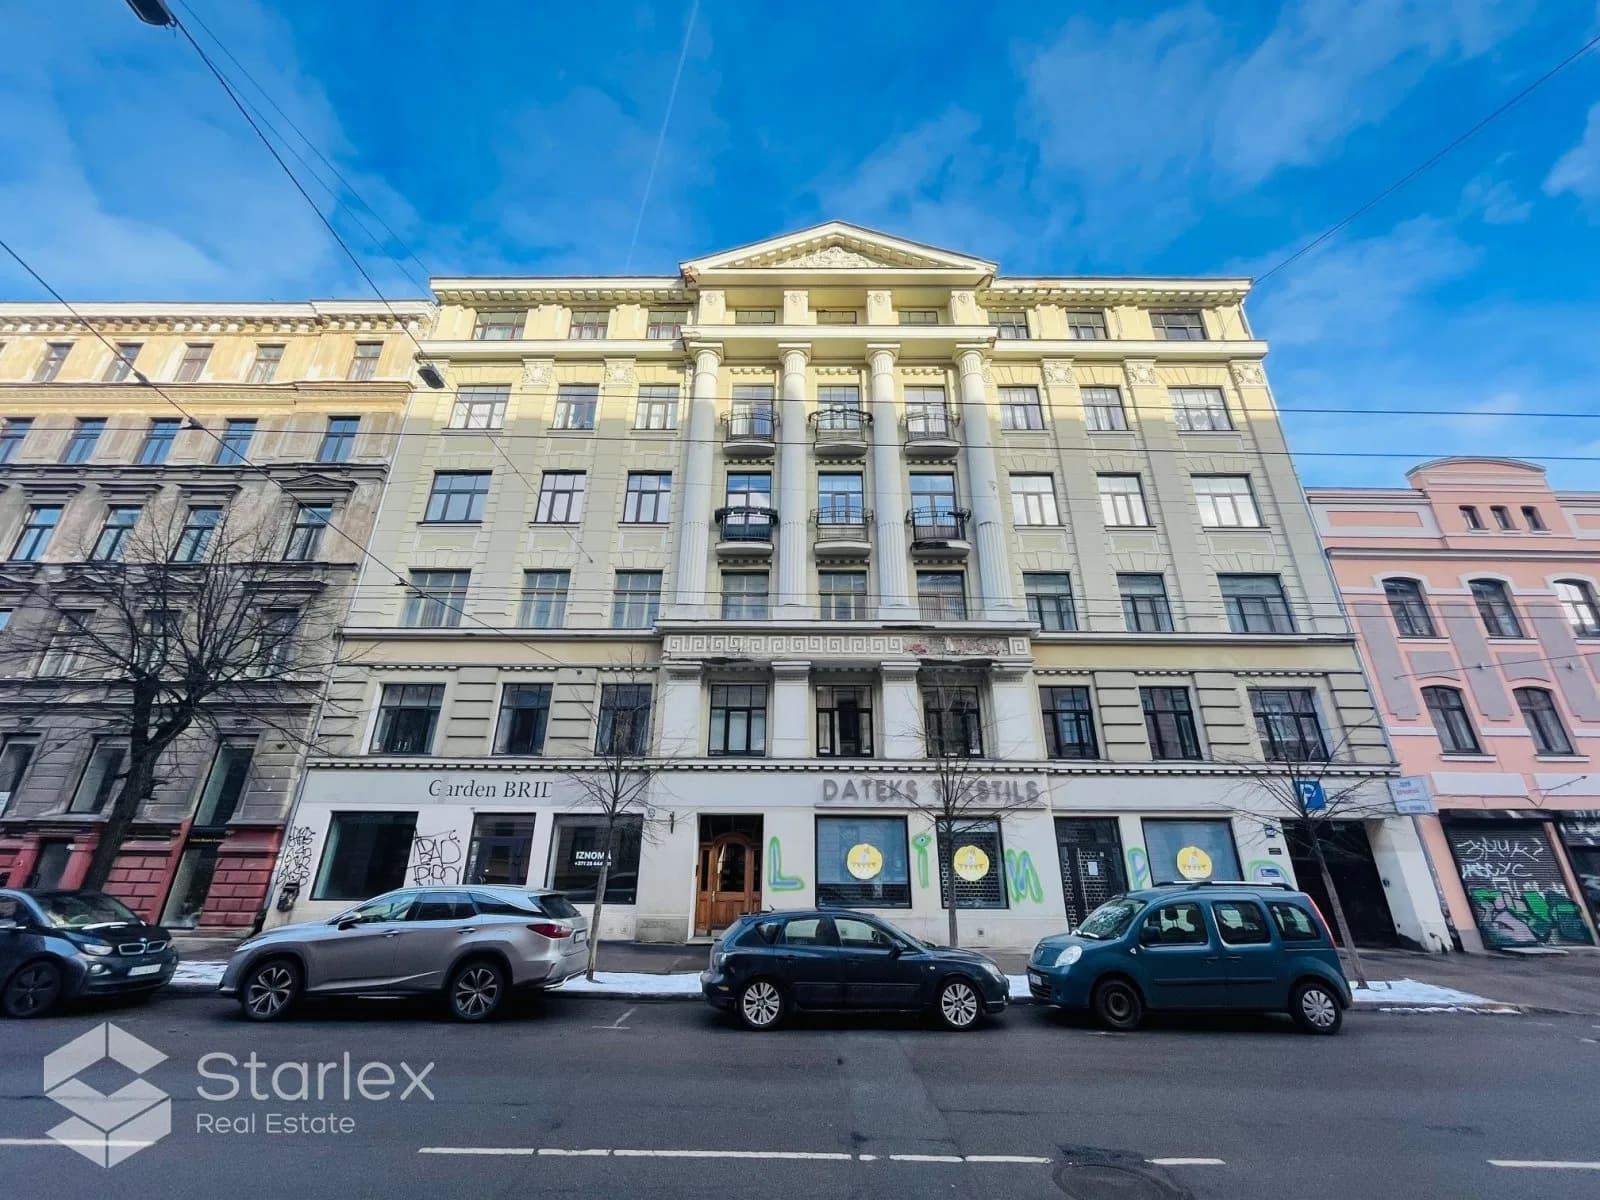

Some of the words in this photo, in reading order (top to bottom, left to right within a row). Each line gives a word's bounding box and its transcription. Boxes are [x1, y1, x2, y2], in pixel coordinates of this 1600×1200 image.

[428, 780, 496, 797] Garden
[822, 779, 918, 802] DATEKS
[1299, 783, 1317, 806] P
